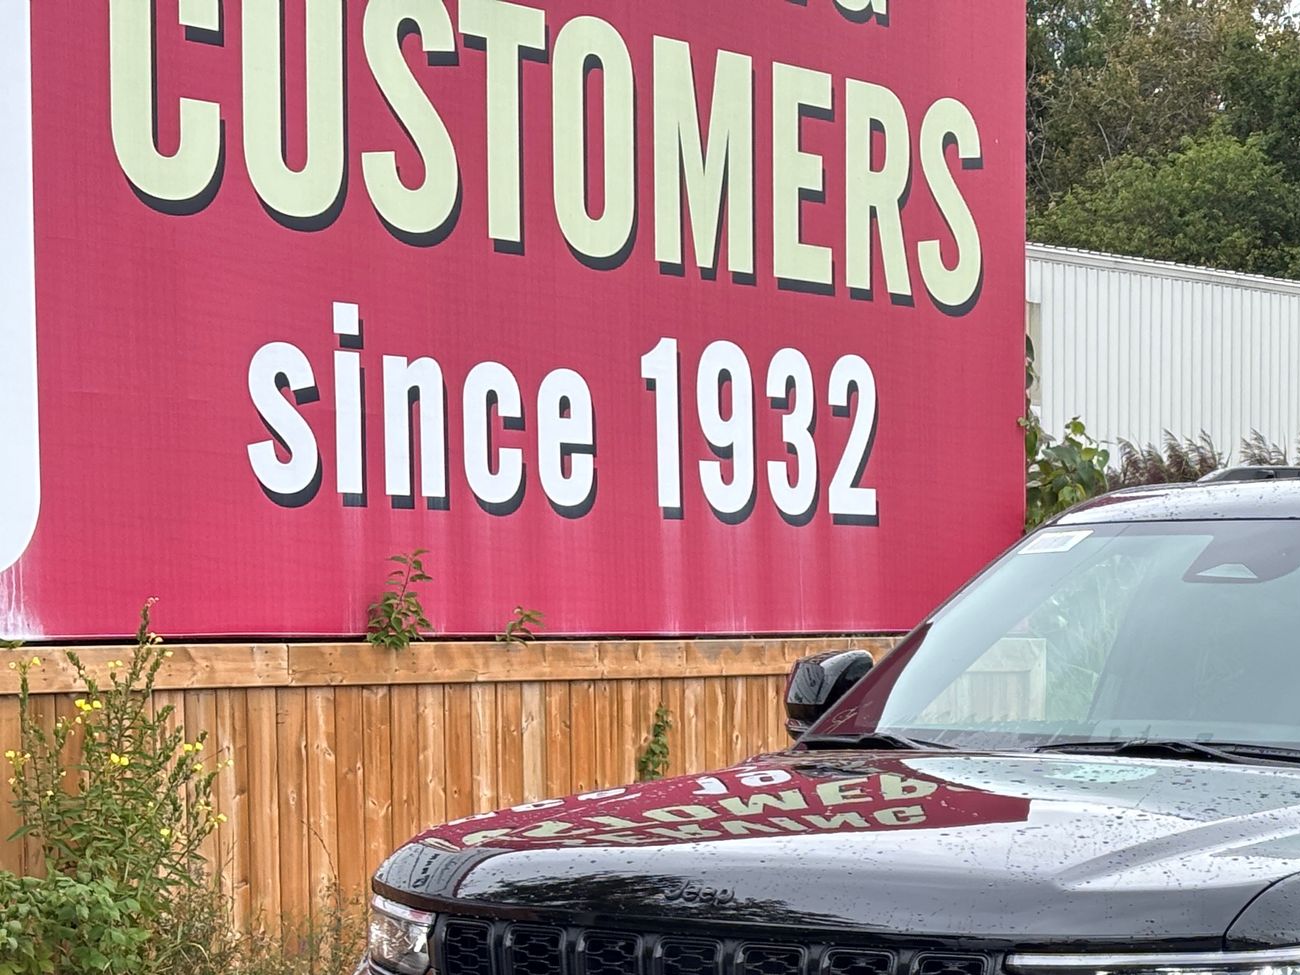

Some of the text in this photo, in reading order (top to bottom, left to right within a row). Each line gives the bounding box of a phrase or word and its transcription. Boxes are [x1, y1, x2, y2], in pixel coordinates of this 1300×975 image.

[109, 0, 982, 309] CUSTOMERS
[247, 301, 879, 519] since 1932
[663, 879, 735, 907] Jeep
